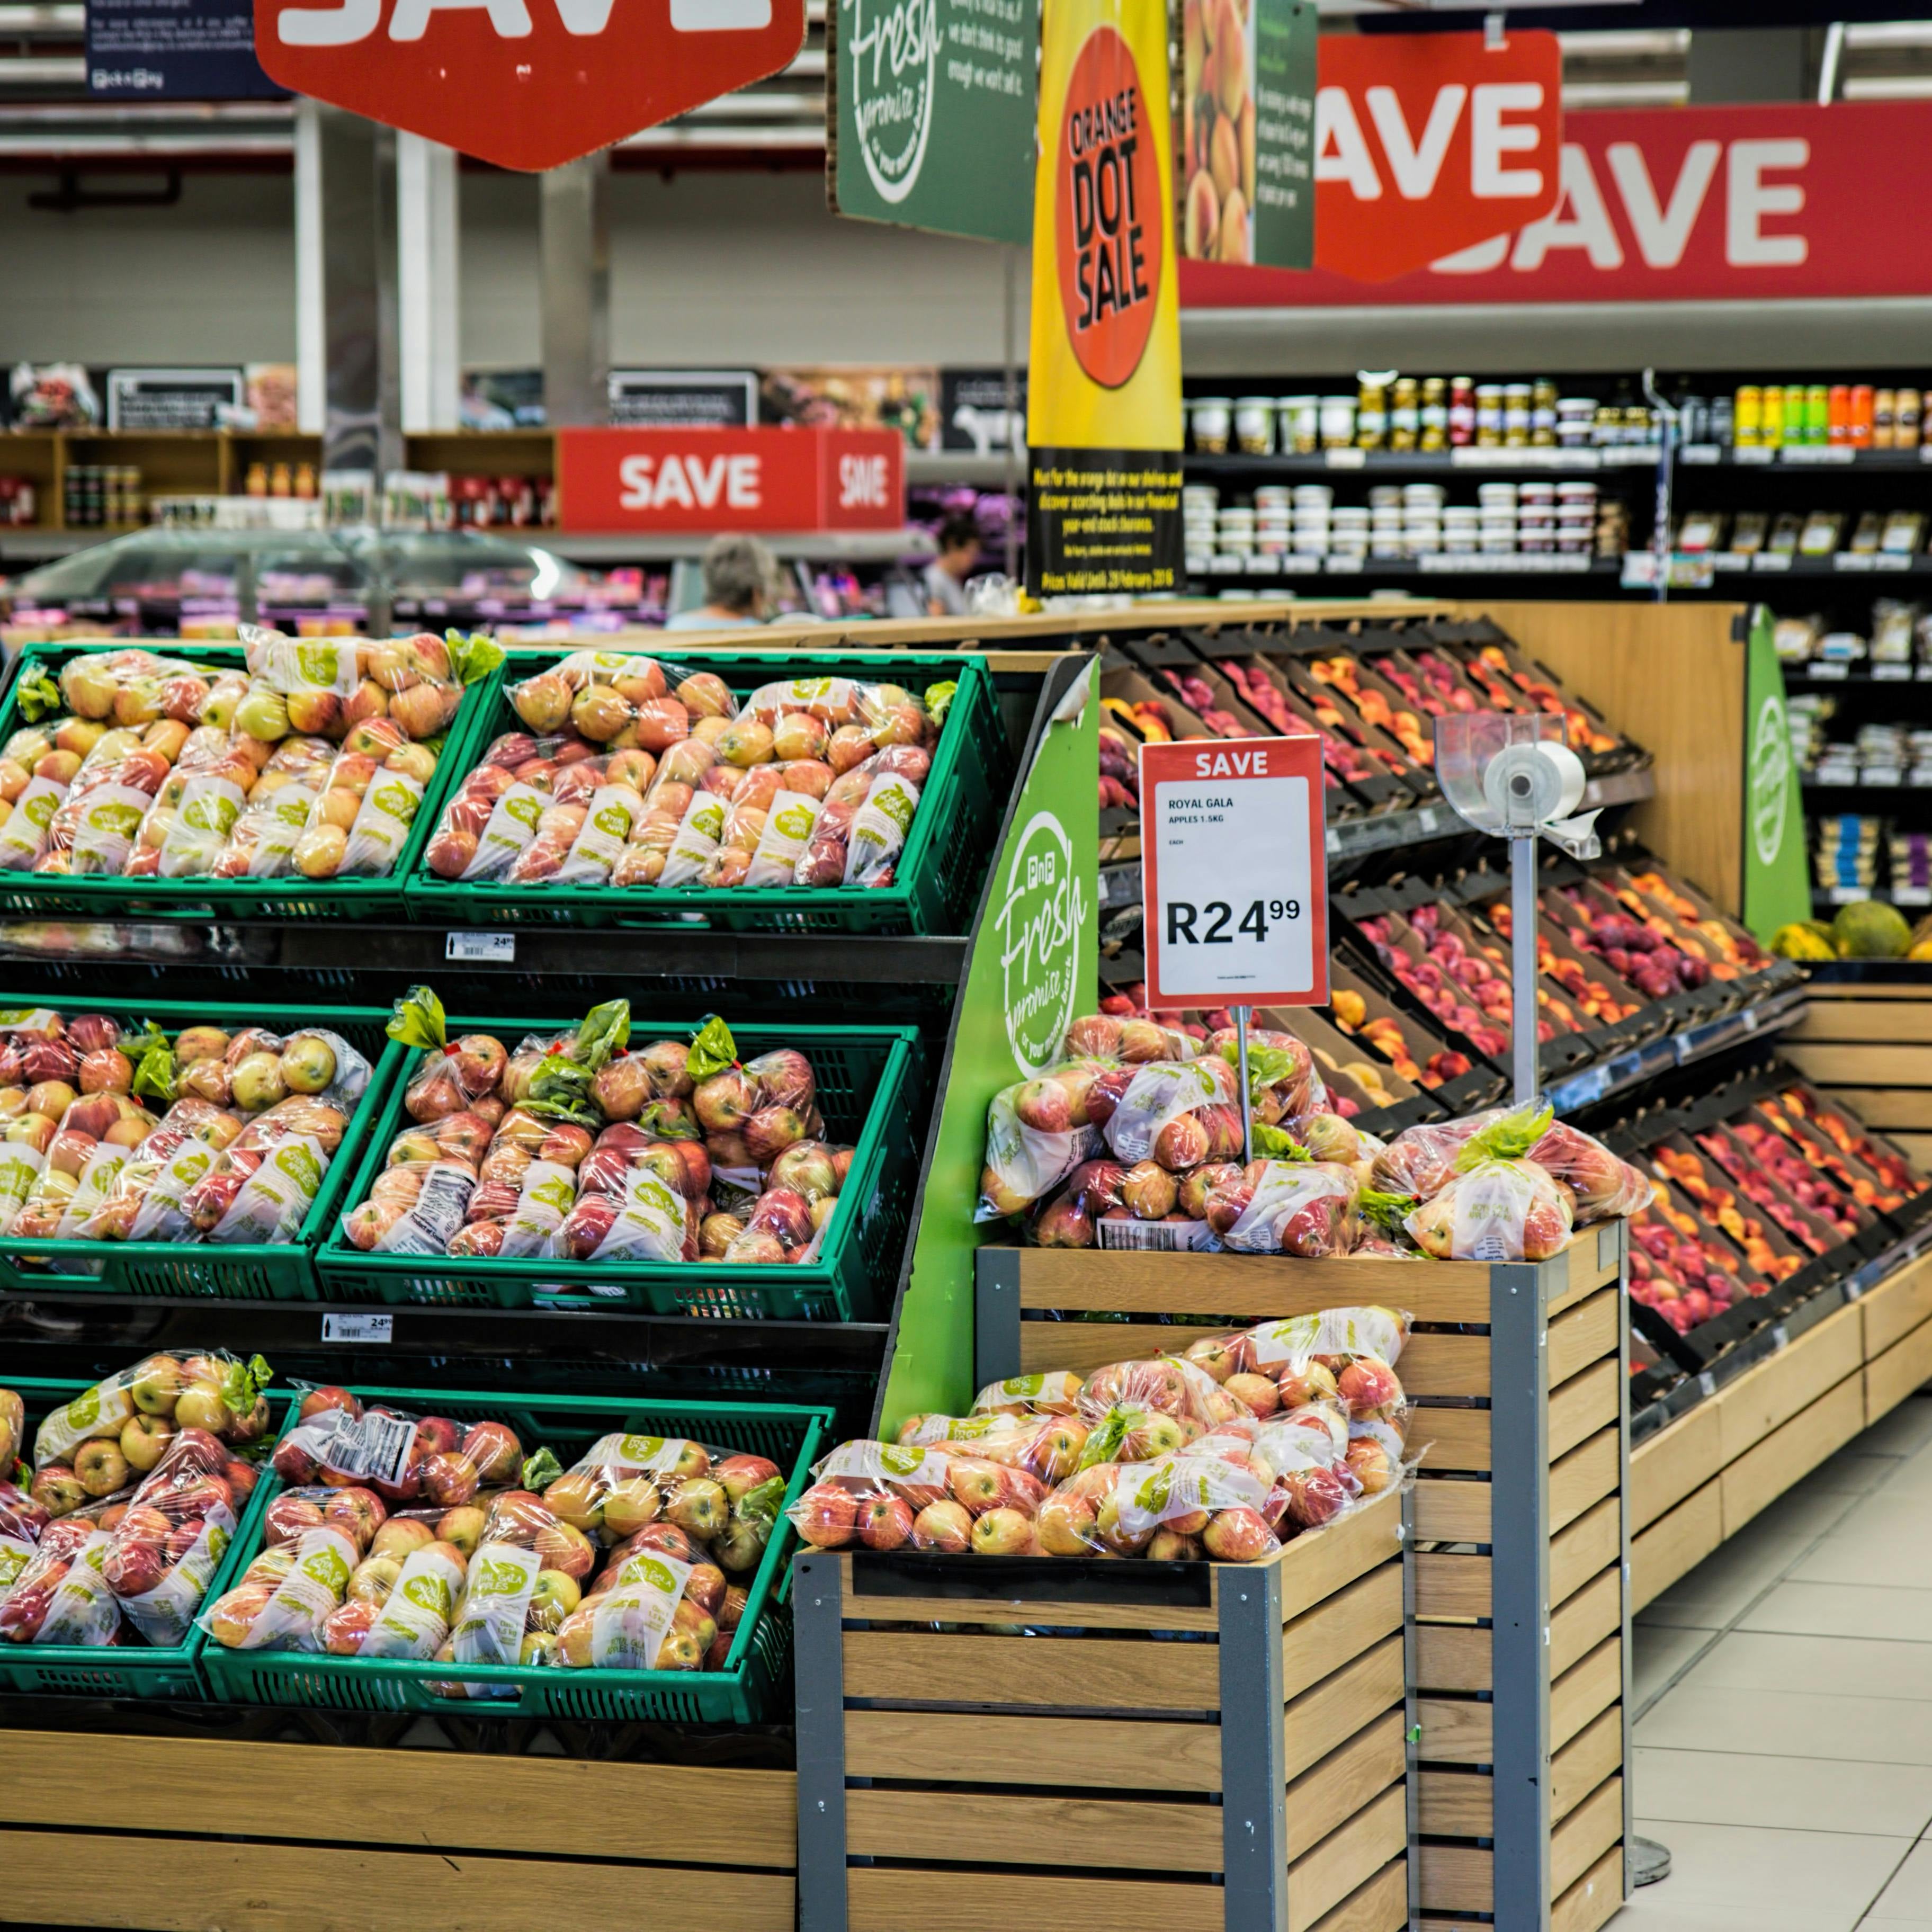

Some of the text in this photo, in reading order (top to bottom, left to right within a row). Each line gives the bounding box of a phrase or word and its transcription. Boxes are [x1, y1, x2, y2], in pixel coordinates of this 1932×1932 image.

[1069, 87, 1137, 158] ORANGE
[1314, 82, 1544, 200] AVE
[1072, 137, 1137, 252] DOT
[1429, 138, 1810, 272] AVE
[1075, 223, 1149, 333] SALE
[619, 453, 763, 510] SAVE
[1169, 798, 1233, 810] ROYAL GALA
[1196, 751, 1268, 777] SAVE
[1169, 815, 1224, 824] APPLES 1.5KG
[994, 838, 1088, 986] Fresh
[1027, 851, 1056, 890] PnP
[1008, 969, 1060, 1056] promise
[1022, 953, 1073, 1060] or your money back
